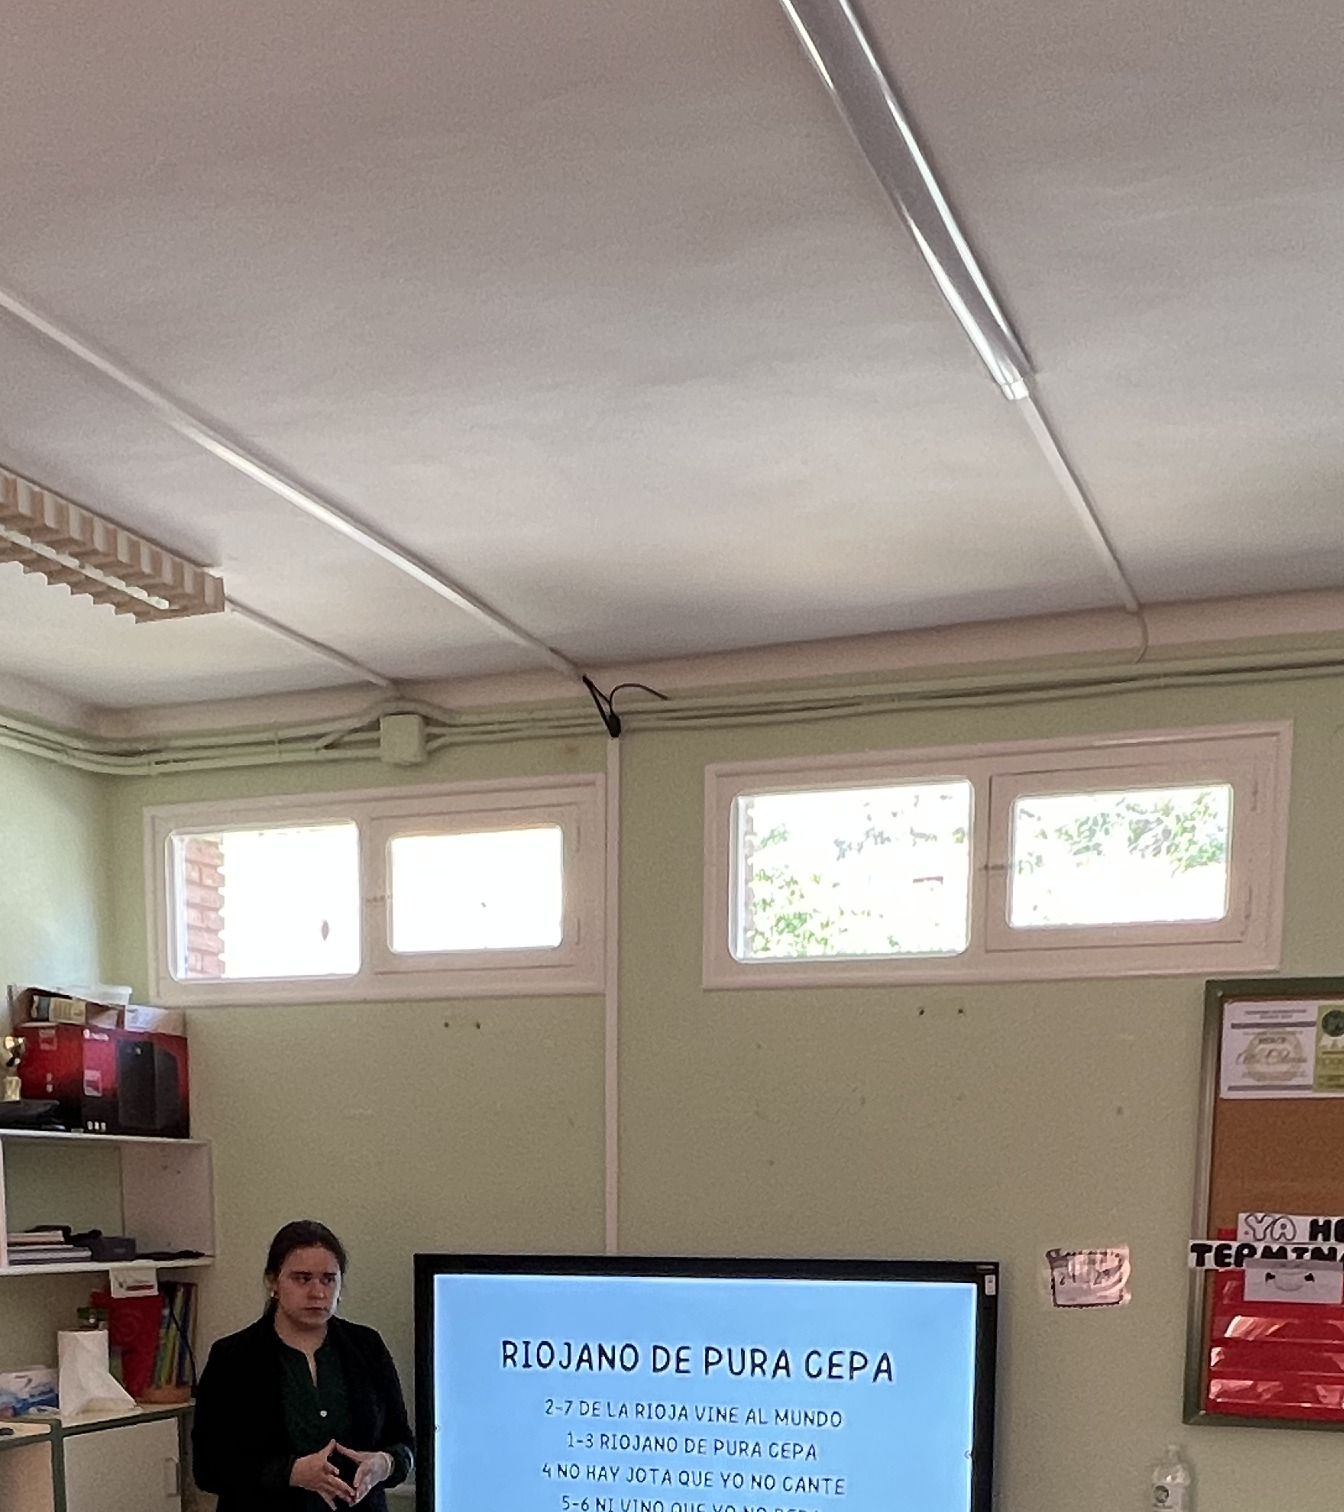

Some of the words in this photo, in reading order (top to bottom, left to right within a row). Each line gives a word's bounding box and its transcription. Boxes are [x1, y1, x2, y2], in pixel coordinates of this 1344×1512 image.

[1244, 1213, 1297, 1241] YA
[502, 1340, 639, 1372] RIOJANO
[653, 1345, 691, 1374] DE
[705, 1346, 791, 1380] PURA
[805, 1350, 893, 1383] CEPA
[545, 1399, 573, 1416] 2-7
[579, 1400, 601, 1417] DE
[607, 1402, 628, 1419] LA
[635, 1402, 688, 1421] RIOJA
[694, 1405, 739, 1424] VINE
[745, 1408, 769, 1425] AL
[774, 1409, 842, 1428] MUNDO
[567, 1431, 594, 1449] 1-3
[600, 1433, 678, 1453] RIOJANO
[684, 1437, 707, 1455] DE
[714, 1439, 762, 1458] PURA
[769, 1442, 817, 1462] CEPA
[542, 1462, 552, 1479] 4
[557, 1463, 580, 1480] NO
[586, 1464, 620, 1483] HAY
[626, 1466, 672, 1486] JOTA
[678, 1470, 714, 1488] QUE
[720, 1472, 744, 1489] YO
[751, 1473, 776, 1491] NO
[782, 1476, 846, 1496] CANTE
[562, 1495, 590, 1512] 5-6
